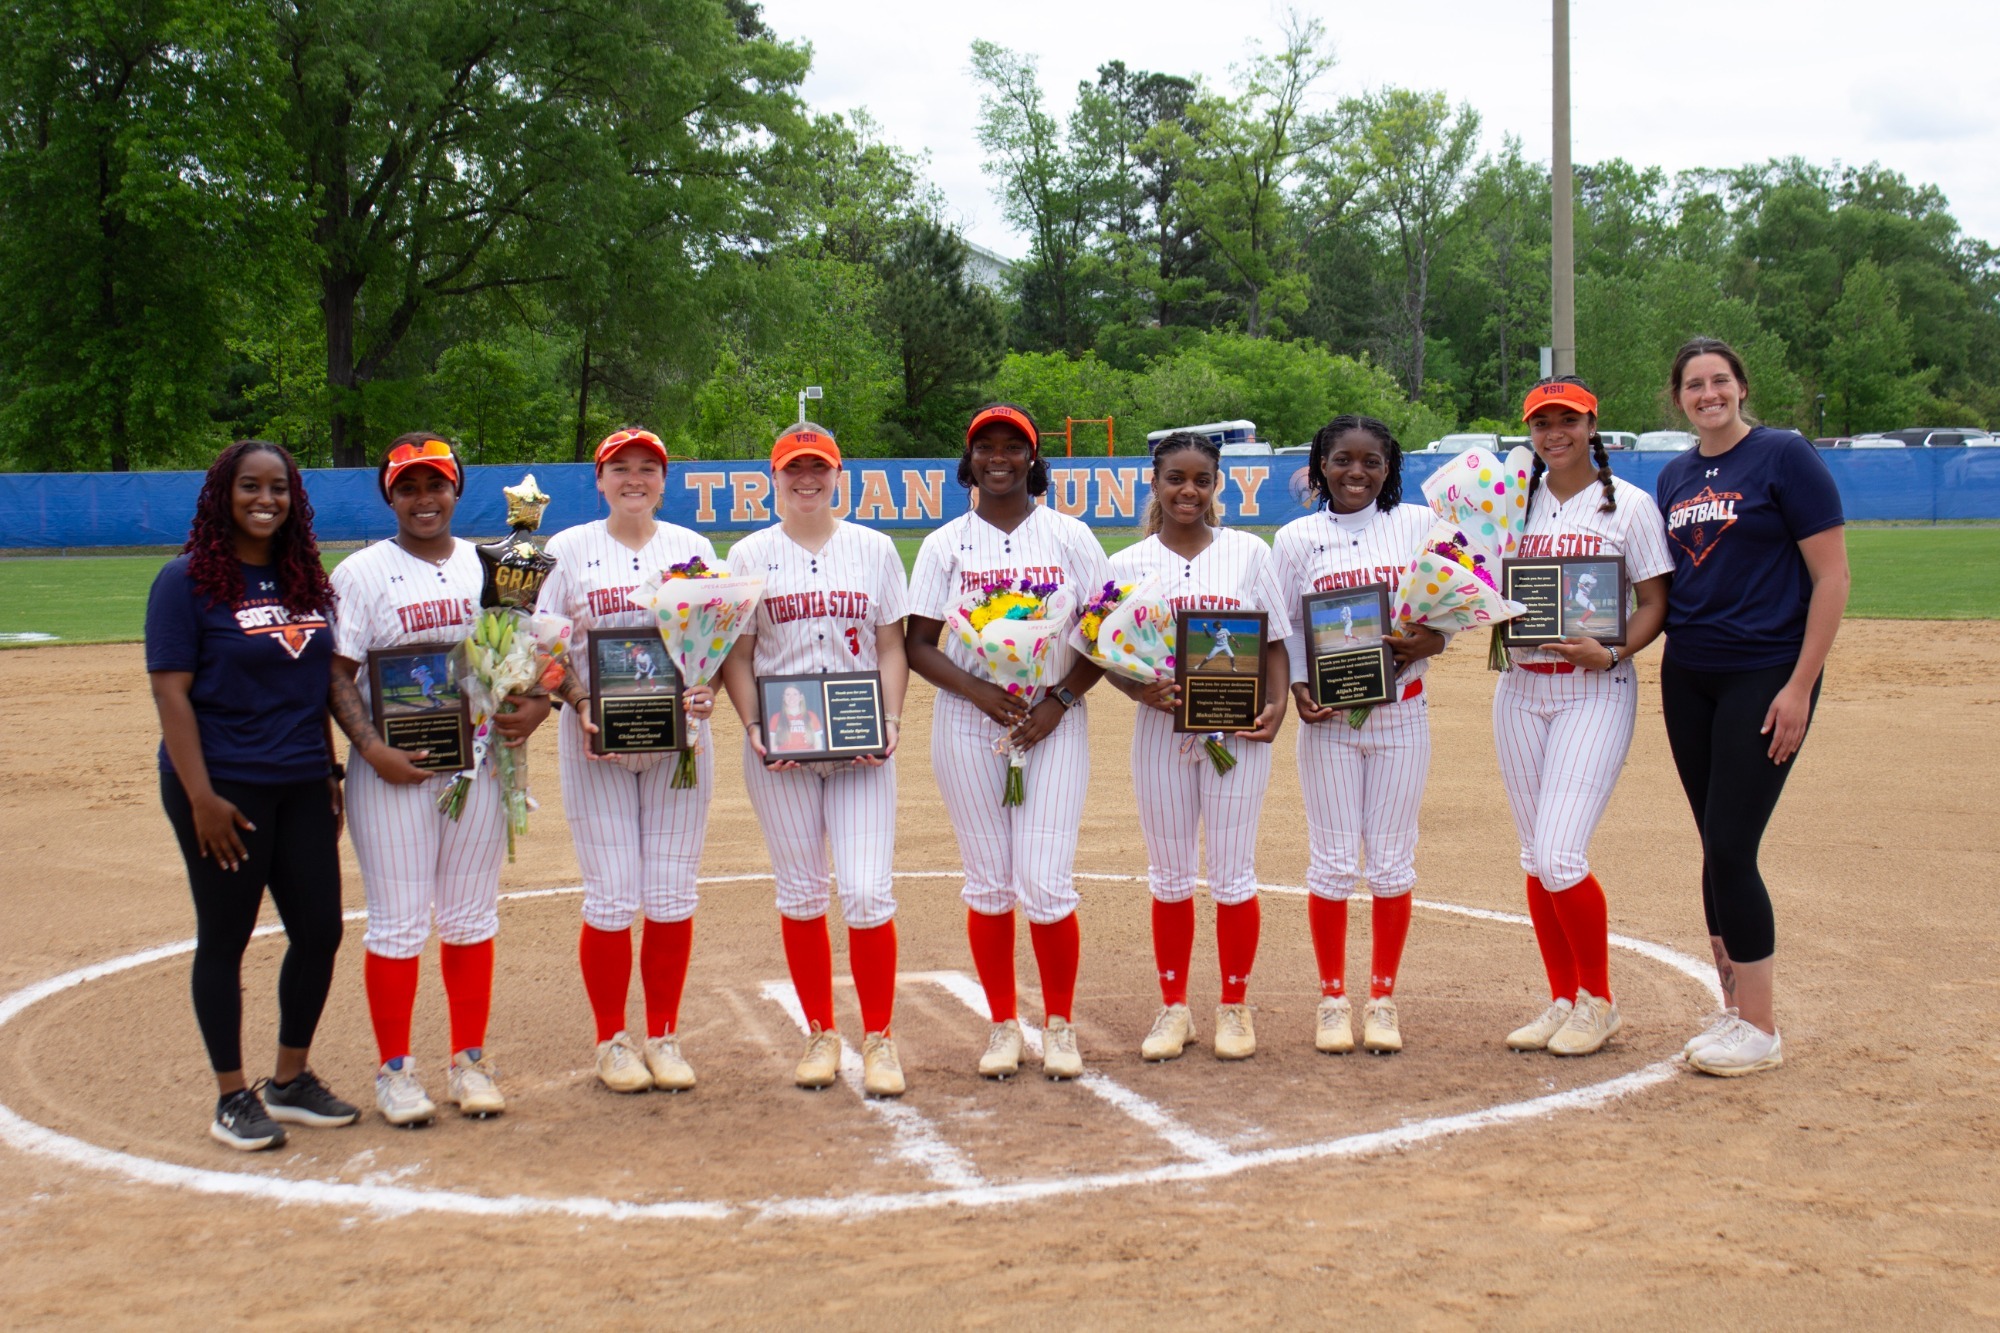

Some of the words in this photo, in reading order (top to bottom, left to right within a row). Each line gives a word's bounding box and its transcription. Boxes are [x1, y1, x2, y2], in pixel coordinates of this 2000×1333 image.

[1543, 385, 1564, 395] VSU
[990, 408, 1012, 416] VSU
[795, 433, 817, 443] VSU
[685, 469, 945, 522] TRJAN
[1667, 500, 1738, 531] SOFTBALL
[1517, 534, 1554, 558] GINIA
[1556, 533, 1603, 557] STATE
[960, 568, 1019, 595] VIRGINIA
[1024, 565, 1065, 585] STATE
[1313, 568, 1372, 593] VIRGINIA
[1374, 565, 1405, 592] STA
[396, 598, 464, 634] VIRGINIA
[587, 585, 648, 617] VIRGIN
[763, 590, 828, 625] VIRGINIA
[828, 590, 869, 620] STATE
[234, 605, 326, 629] SOFTBL
[844, 626, 860, 657] 3
